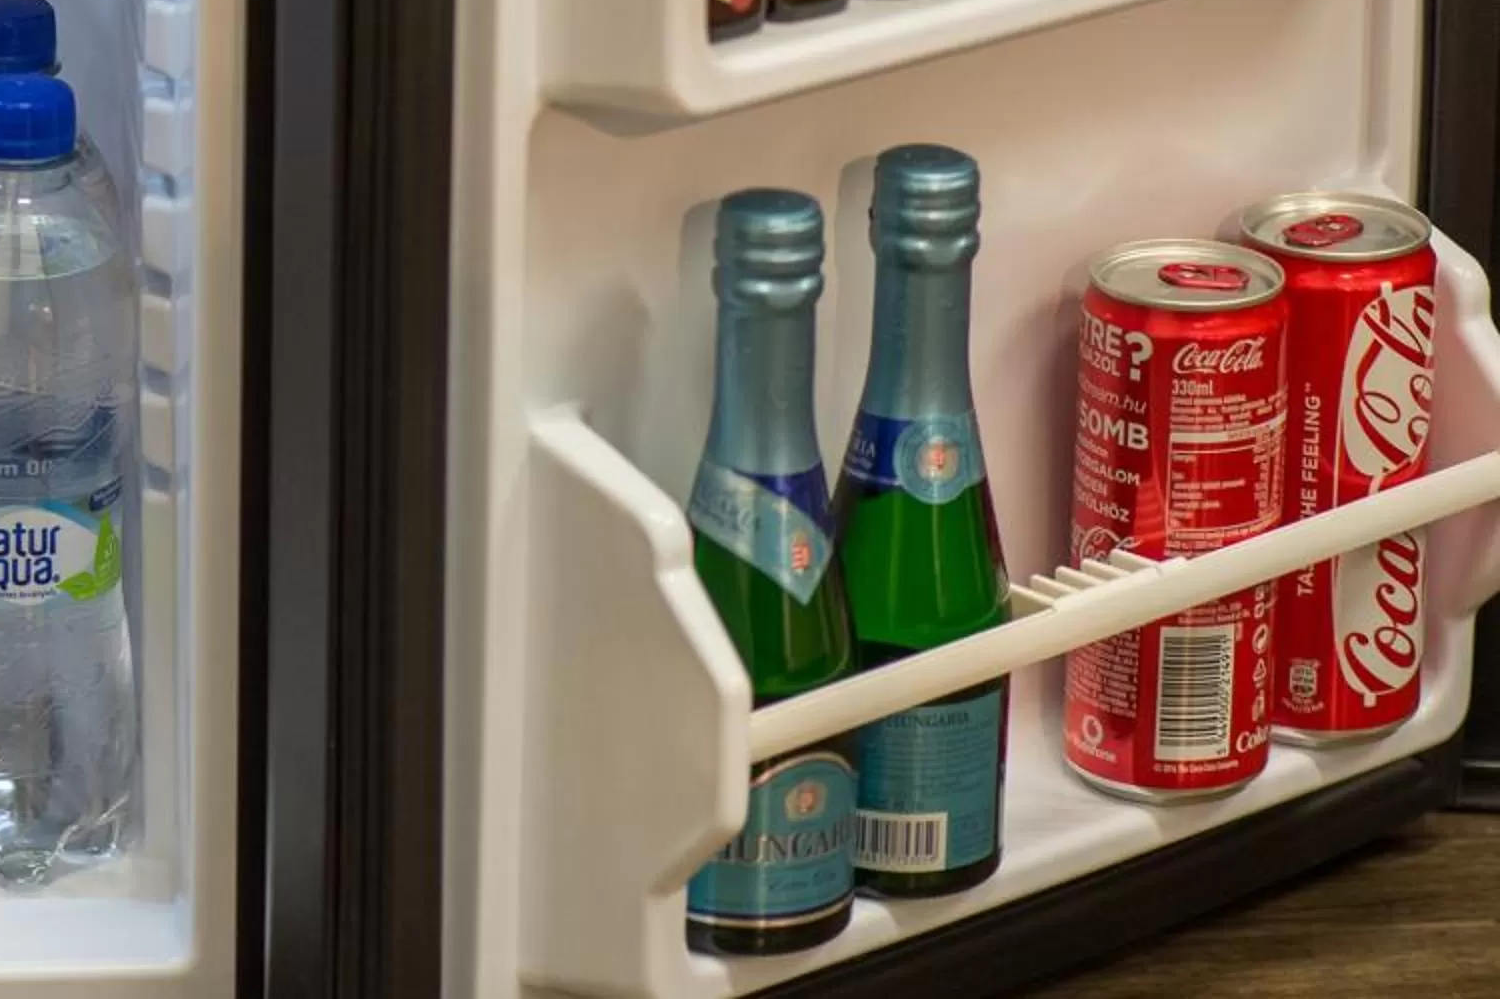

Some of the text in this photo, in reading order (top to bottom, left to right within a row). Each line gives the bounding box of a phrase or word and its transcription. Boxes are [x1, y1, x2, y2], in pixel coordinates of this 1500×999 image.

[1301, 395, 1321, 483] FEELING
[1299, 488, 1318, 520] HE
[1343, 531, 1420, 693] Coca
